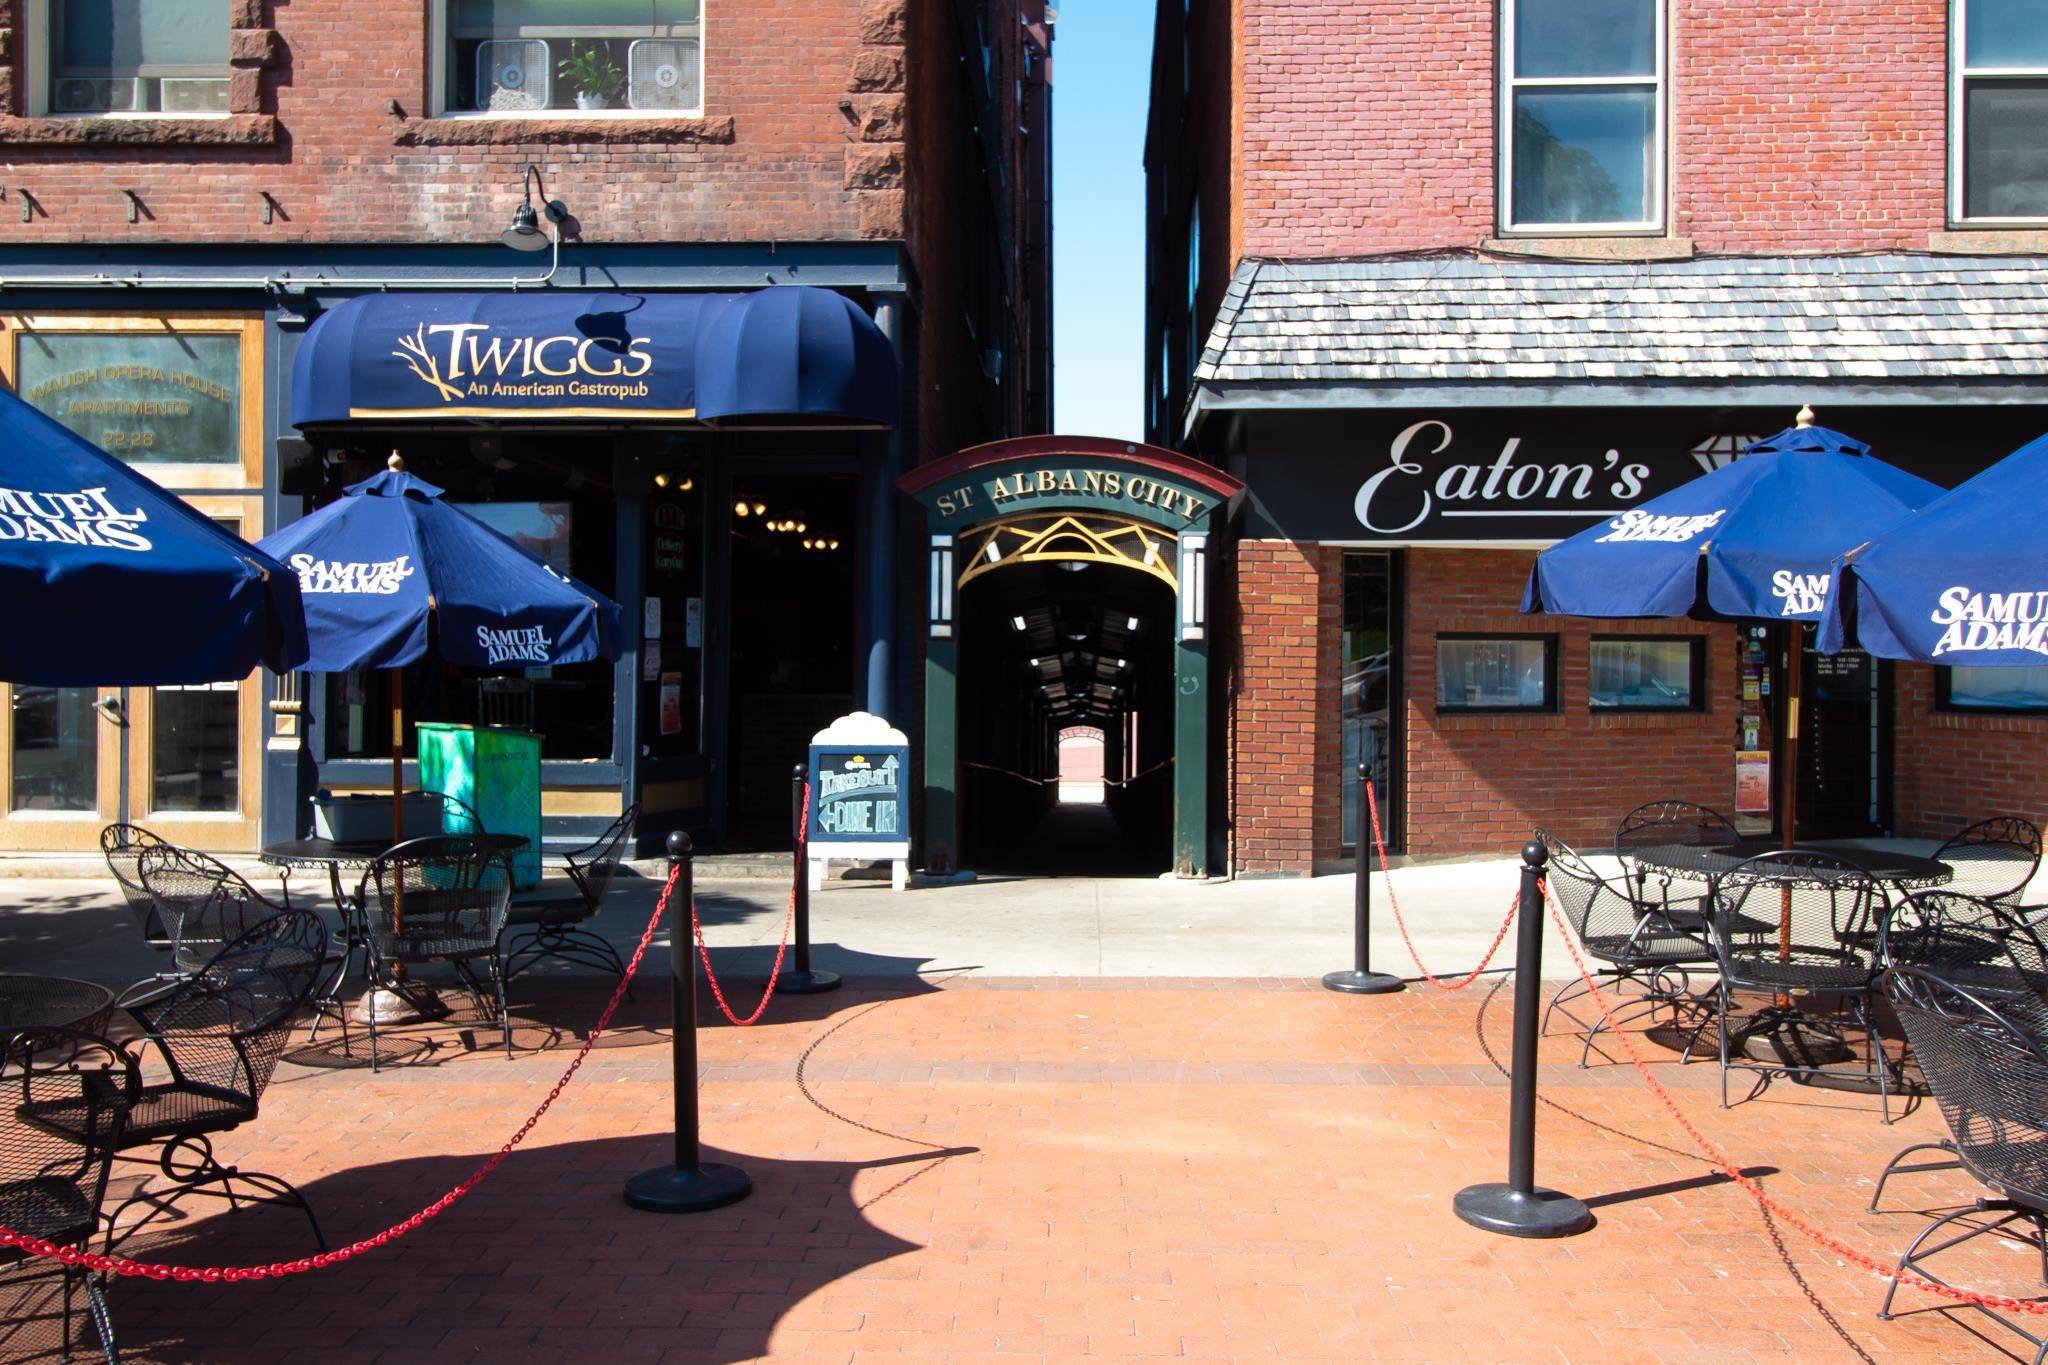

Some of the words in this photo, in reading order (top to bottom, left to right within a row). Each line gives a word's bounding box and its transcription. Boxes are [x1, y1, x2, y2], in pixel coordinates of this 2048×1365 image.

[429, 323, 653, 380] TWIGGS
[28, 367, 98, 401] WAUGH
[102, 365, 165, 382] OPERA
[168, 367, 233, 403] HOUSE
[467, 381, 488, 396] An
[491, 381, 565, 397] American
[568, 380, 649, 400] Gastropub
[67, 399, 192, 416] APARTMENTS
[1354, 420, 1650, 534] Eaton's
[936, 486, 974, 518] ST
[992, 469, 1121, 500] ALBANS
[1126, 477, 1205, 520] CITY
[288, 553, 415, 582] SAMUEL
[299, 573, 401, 595] ADAMS
[1781, 593, 1825, 616] AD
[1930, 586, 2048, 624] SAMU
[477, 625, 552, 648] SAMUEL
[1931, 620, 2048, 657] ADAM
[488, 643, 550, 665] ADAMS
[833, 801, 873, 832] DINE
[875, 800, 897, 832] IN
